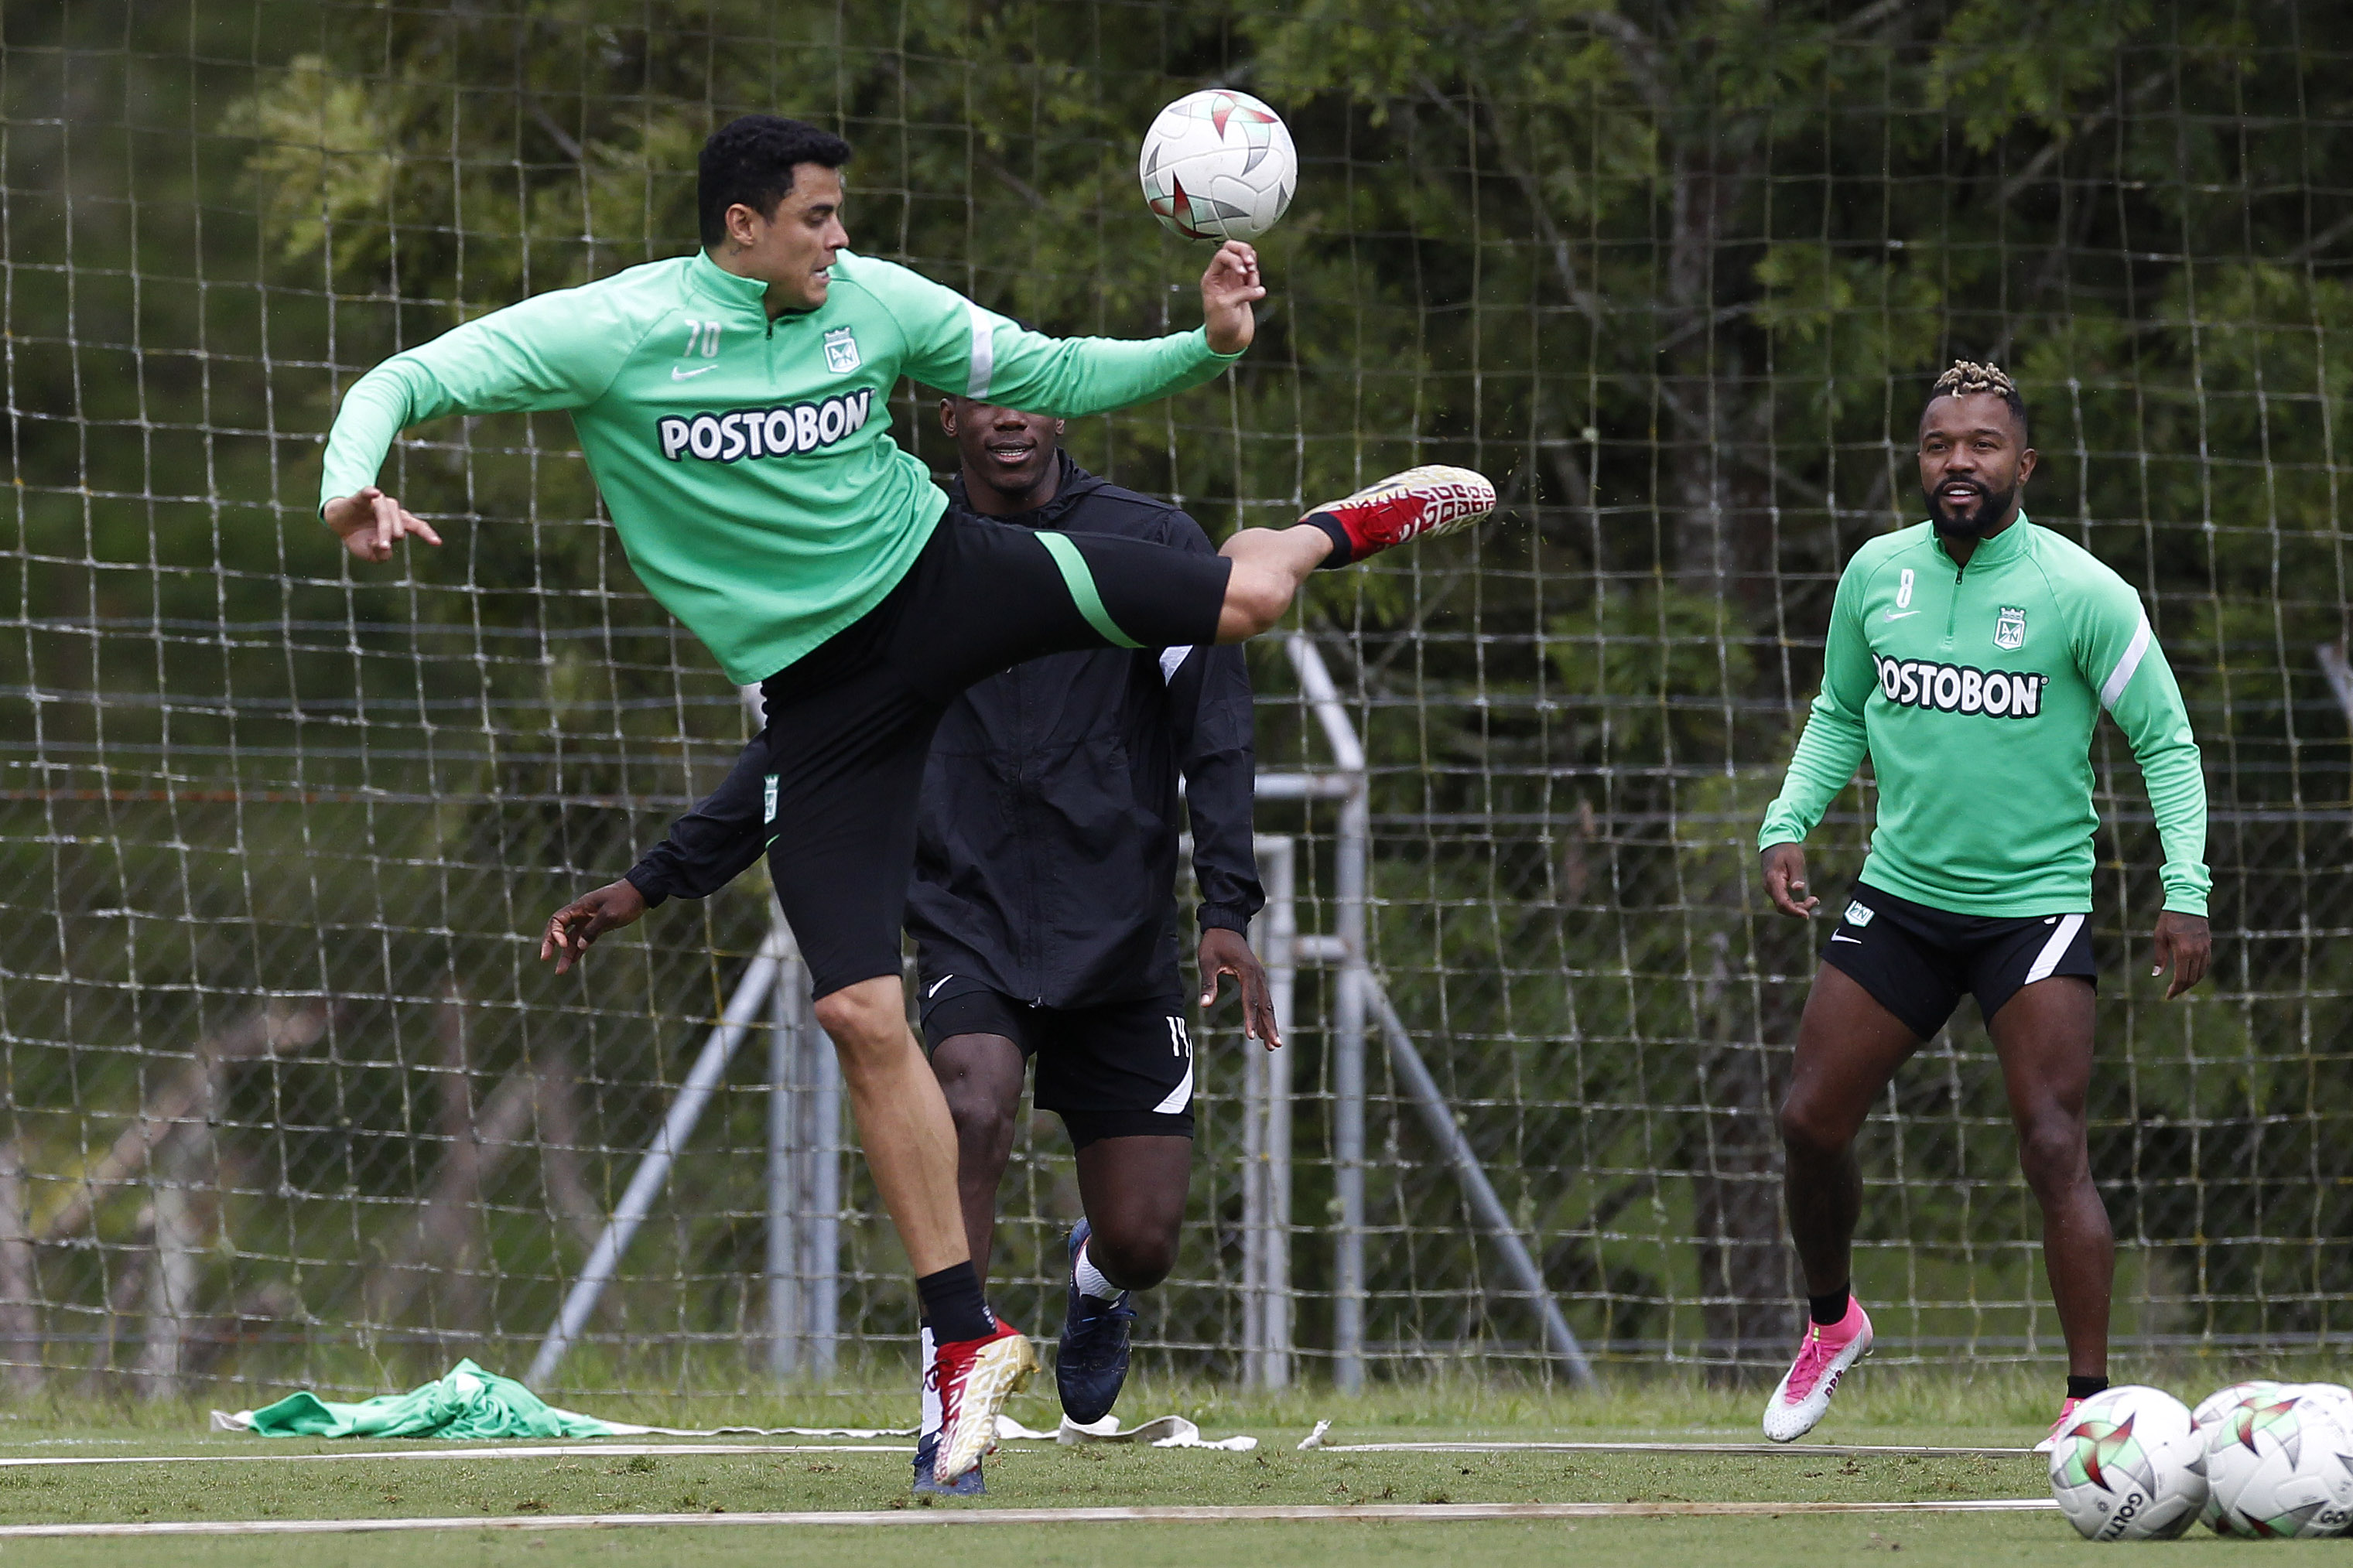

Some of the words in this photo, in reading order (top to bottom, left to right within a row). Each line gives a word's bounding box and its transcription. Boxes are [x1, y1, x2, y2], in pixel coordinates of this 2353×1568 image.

[684, 319, 722, 357] 70
[660, 390, 871, 461] POSTOBON
[1896, 569, 1914, 608] 8
